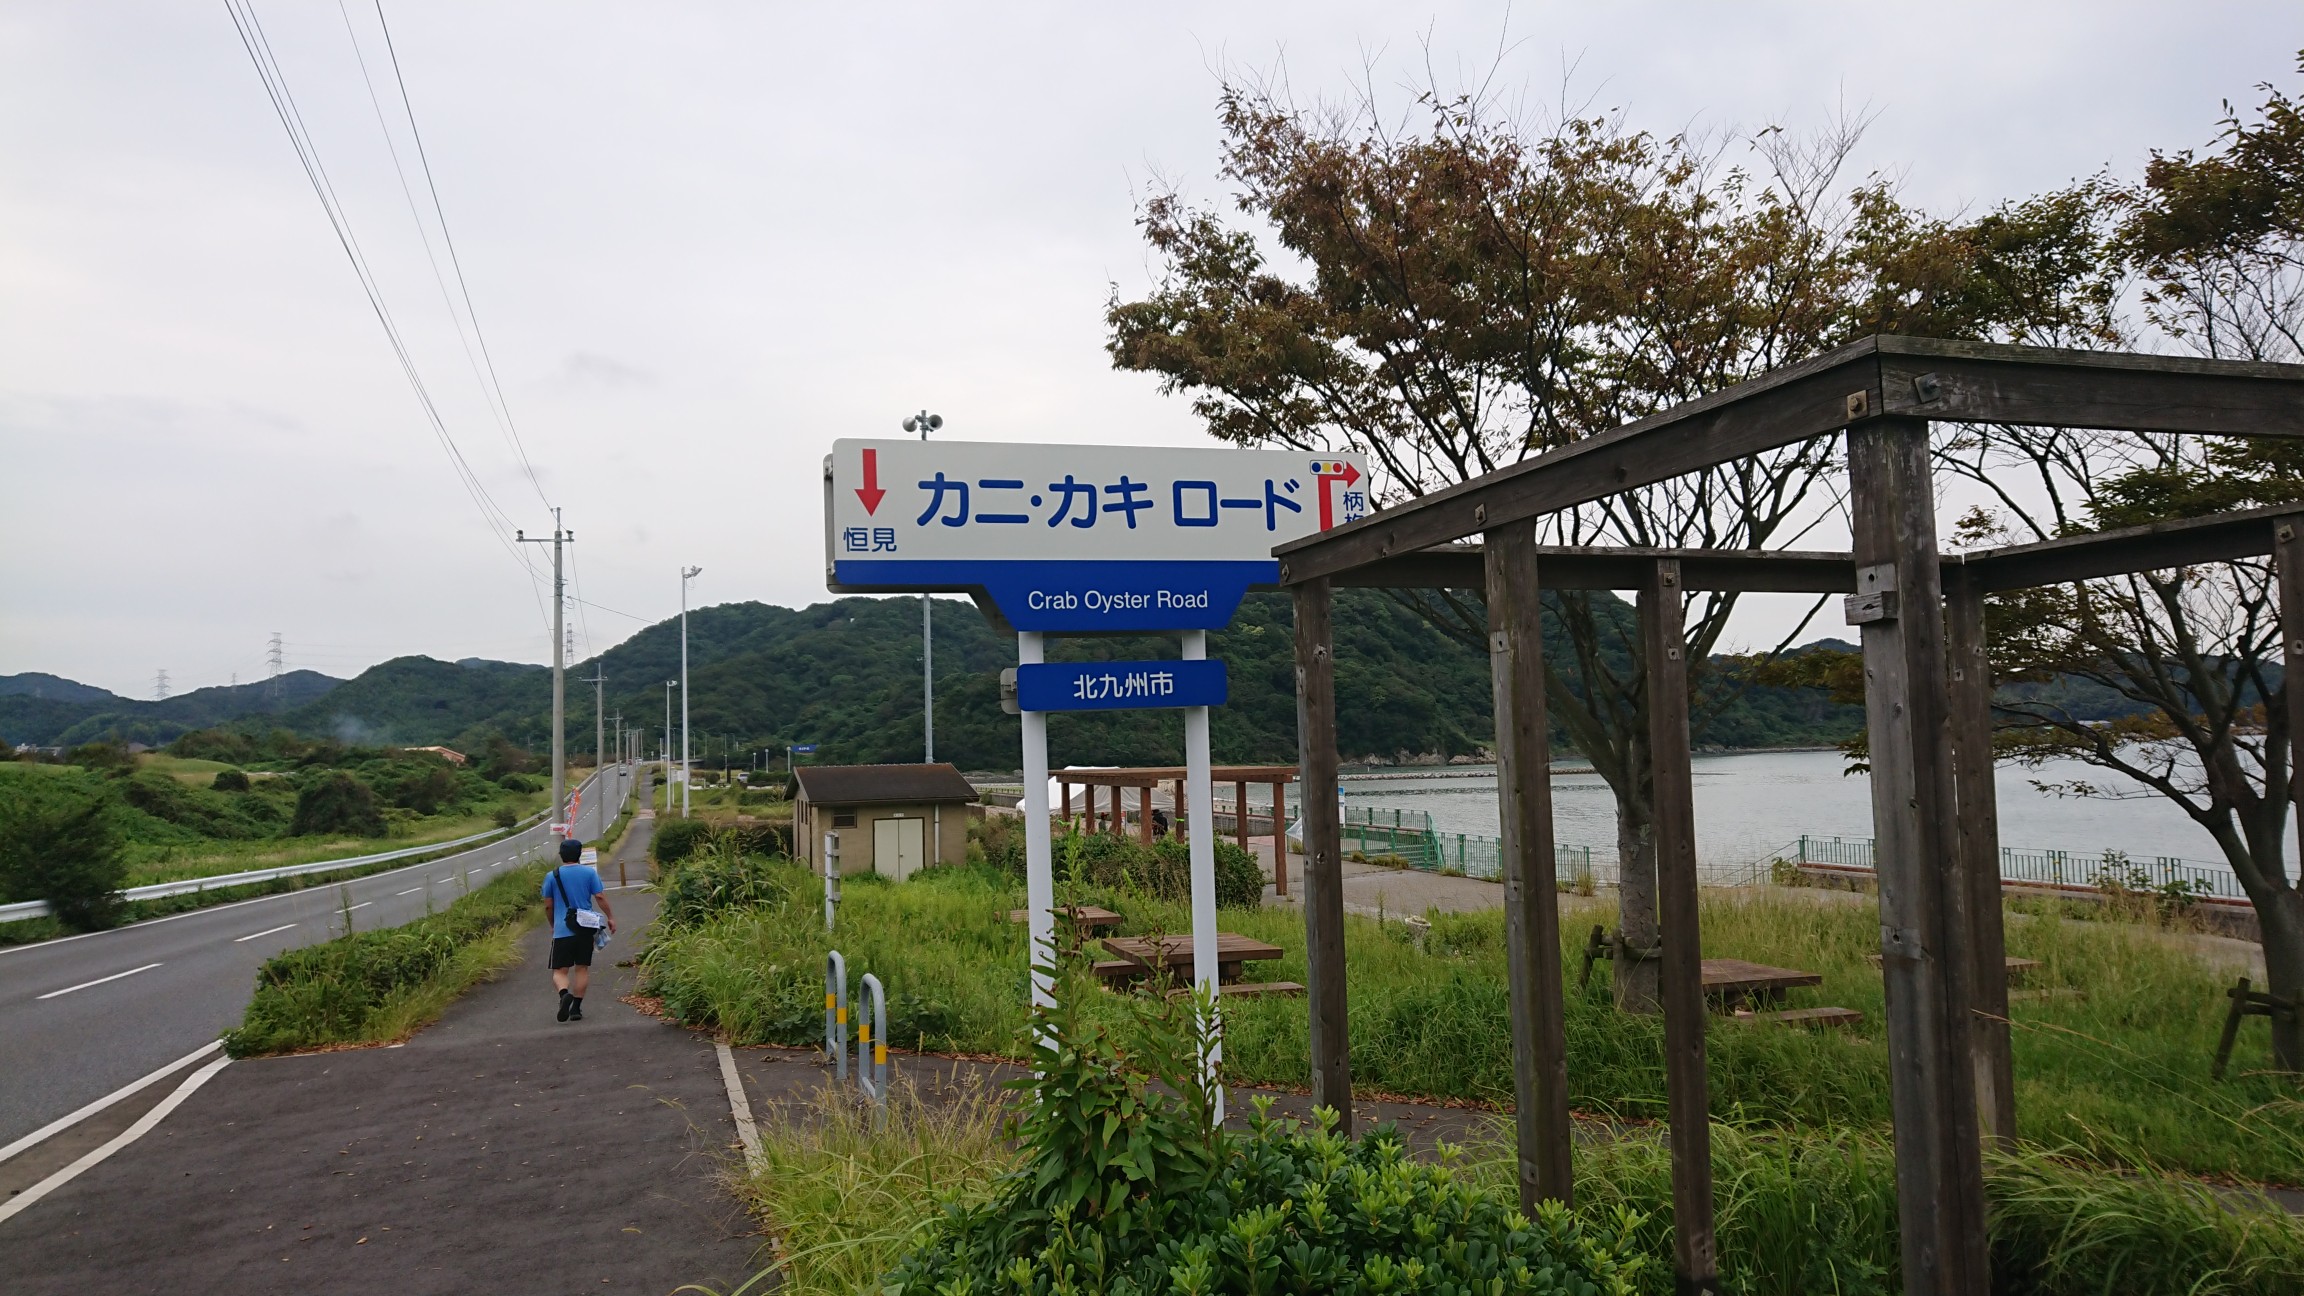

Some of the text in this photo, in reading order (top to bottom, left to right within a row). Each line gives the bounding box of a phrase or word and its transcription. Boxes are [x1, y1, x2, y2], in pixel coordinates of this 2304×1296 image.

[1172, 478, 1302, 532] ロード
[843, 526, 898, 553] 恒見
[1027, 589, 1208, 614] Crab Oyster Road
[1072, 671, 1174, 700] 北九州市
